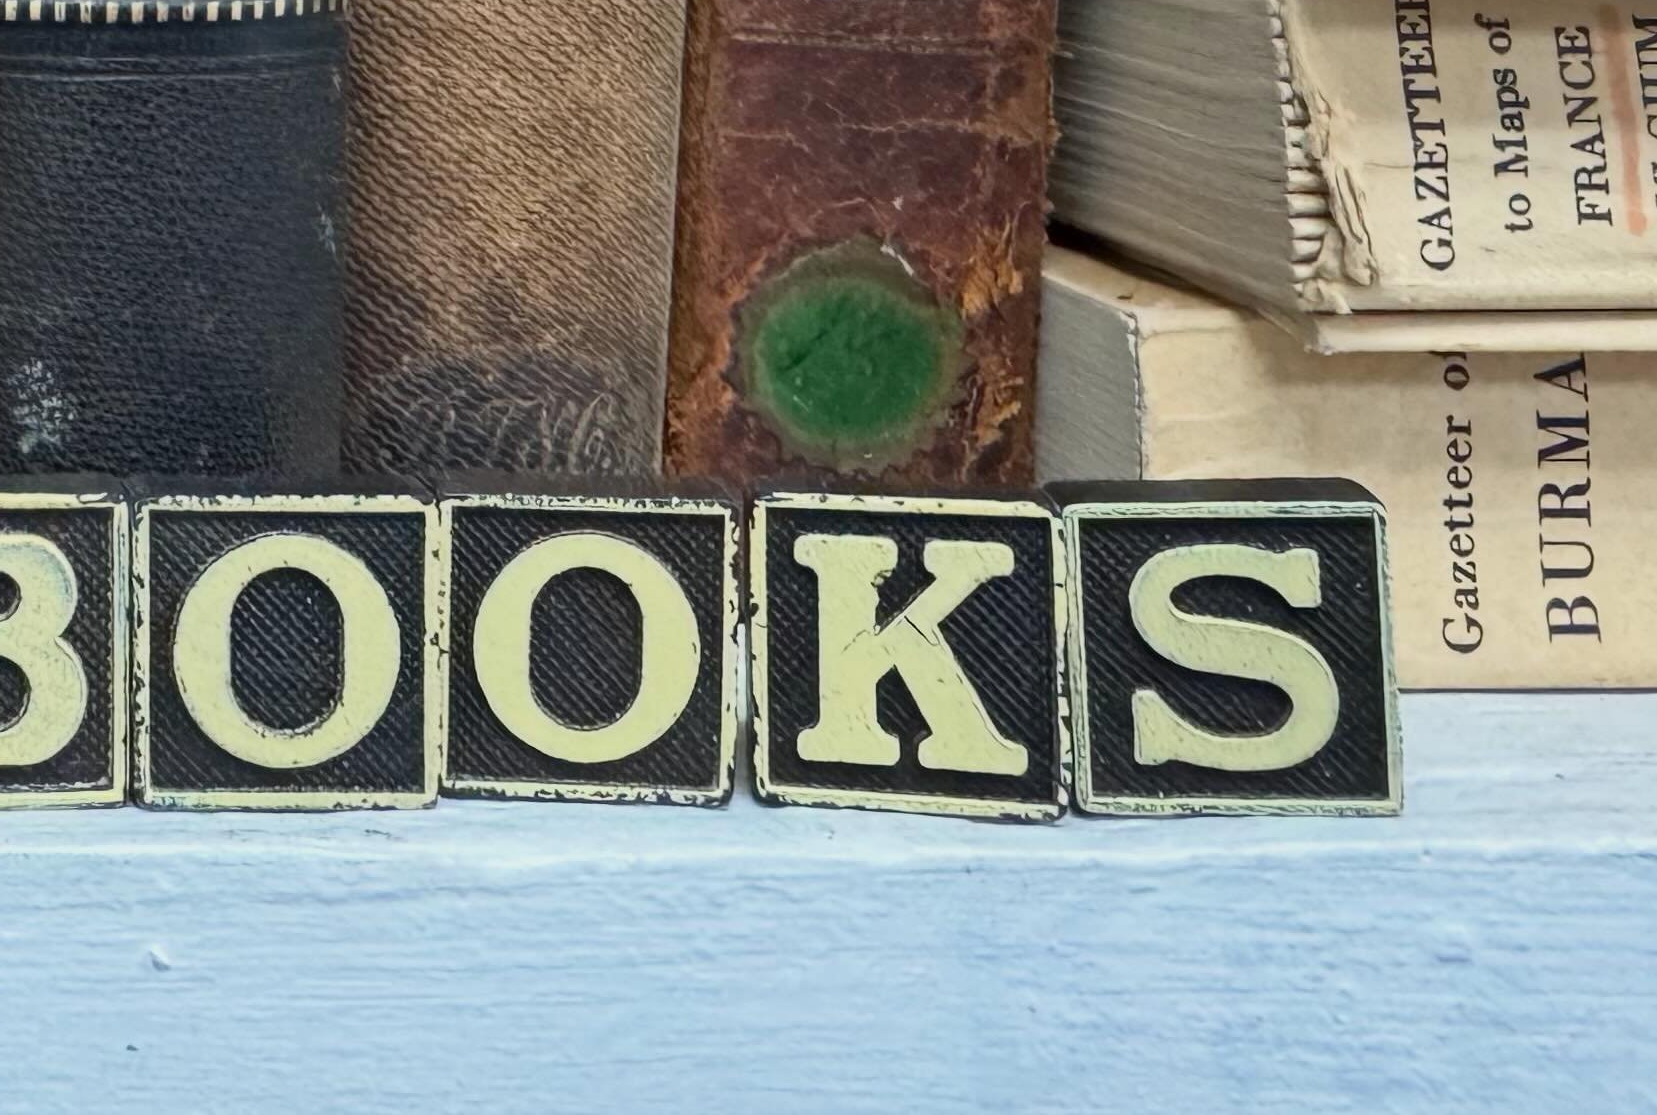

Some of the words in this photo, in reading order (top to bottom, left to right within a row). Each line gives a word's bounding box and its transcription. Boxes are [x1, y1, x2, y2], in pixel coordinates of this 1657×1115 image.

[1473, 12, 1513, 55] of
[1491, 67, 1531, 179] Maps
[1553, 24, 1614, 227] FRANCE
[1503, 192, 1534, 234] to
[1440, 413, 1485, 654] Gazetteer
[1532, 351, 1602, 645] BURMA
